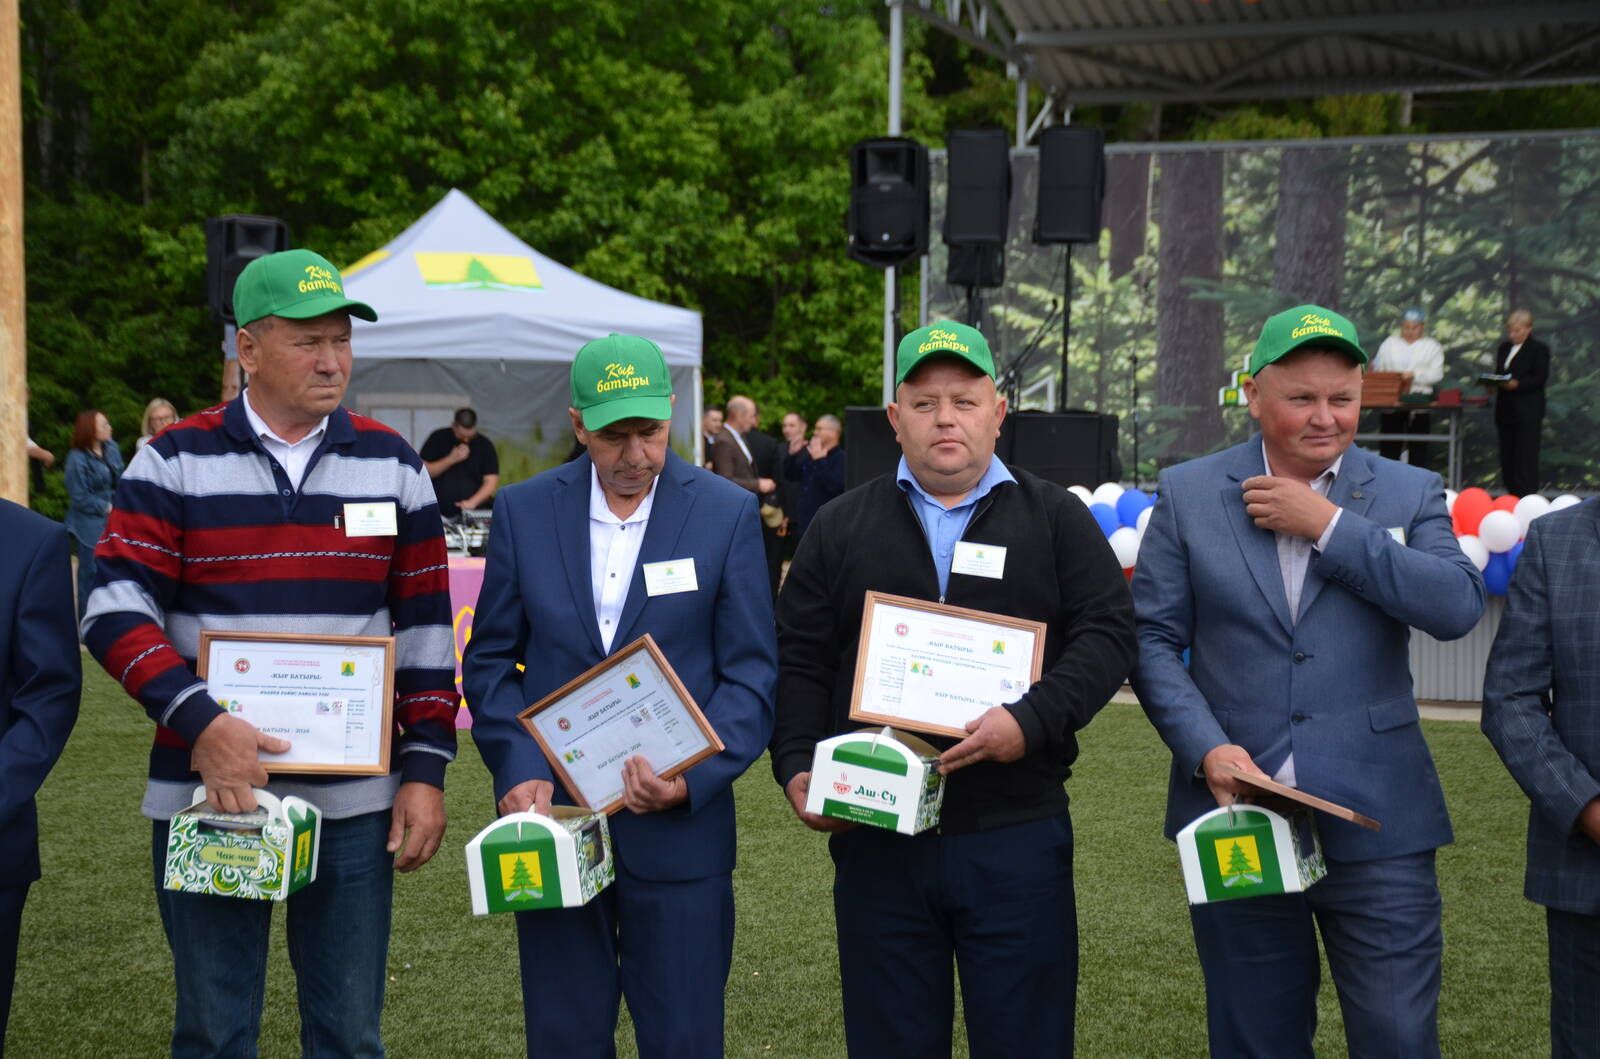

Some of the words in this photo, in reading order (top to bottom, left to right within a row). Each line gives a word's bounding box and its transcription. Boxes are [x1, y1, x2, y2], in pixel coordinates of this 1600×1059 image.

[1301, 314, 1331, 327] Кыр
[928, 329, 958, 343] Кыр
[918, 340, 970, 354] батыры
[604, 362, 636, 380] Кыр
[597, 376, 649, 393] батыры
